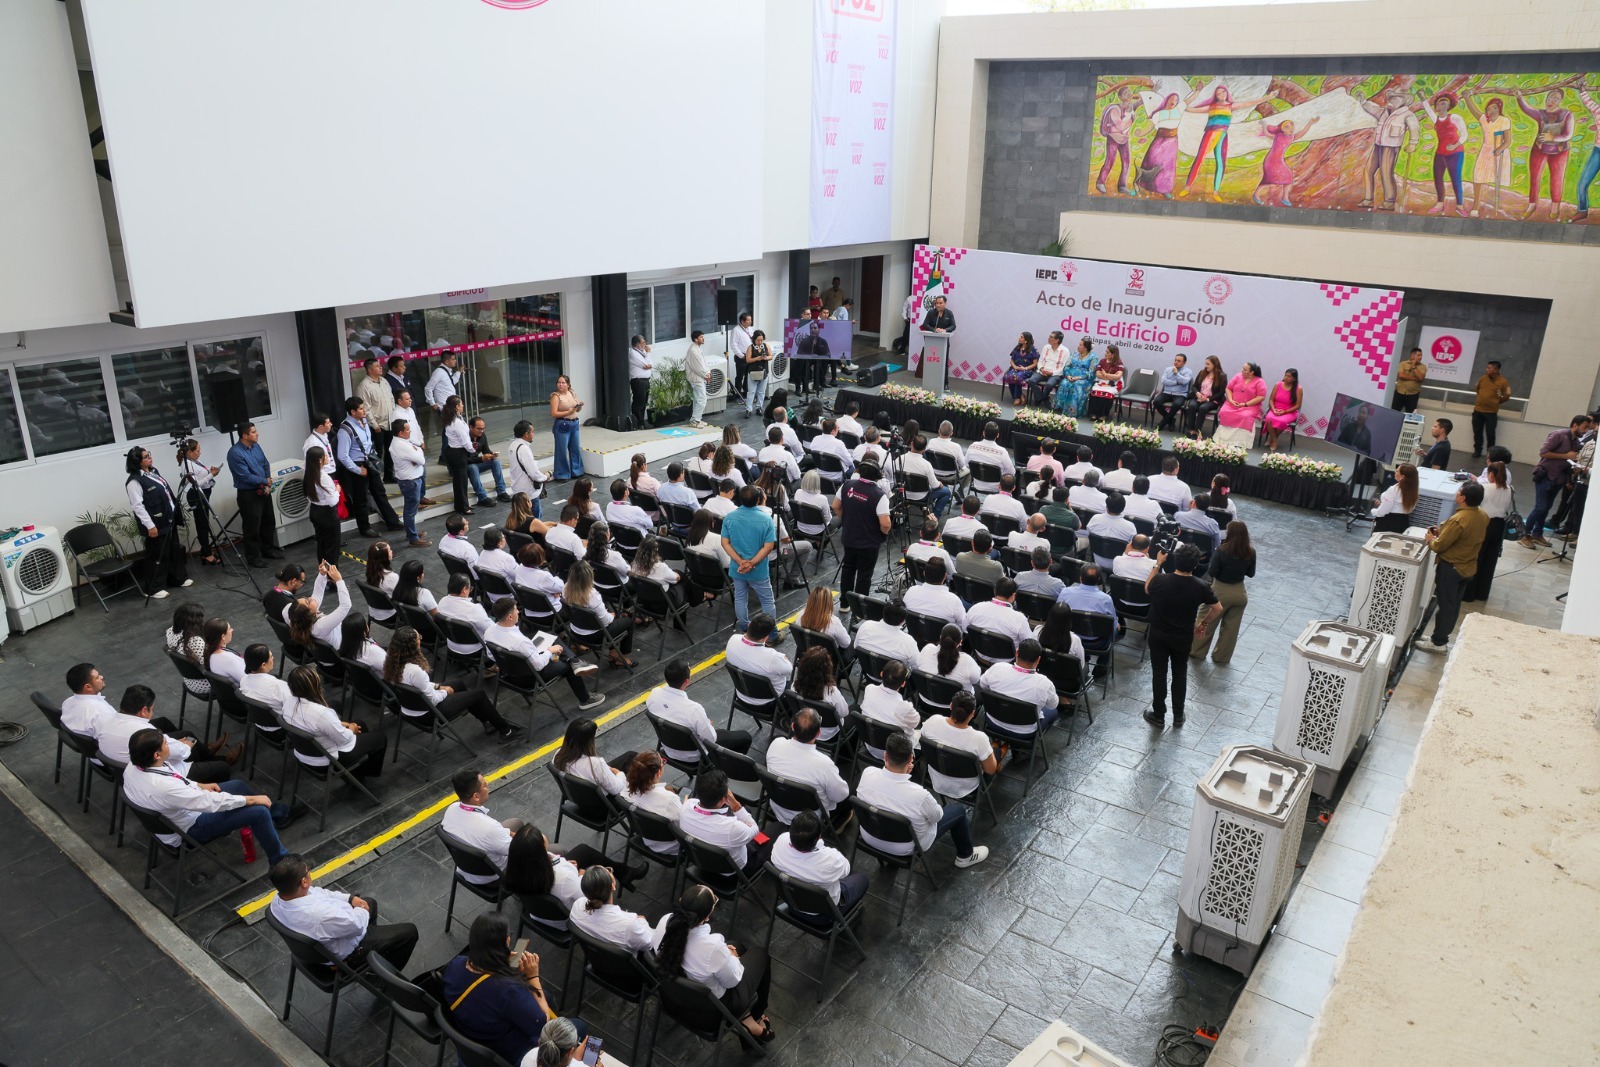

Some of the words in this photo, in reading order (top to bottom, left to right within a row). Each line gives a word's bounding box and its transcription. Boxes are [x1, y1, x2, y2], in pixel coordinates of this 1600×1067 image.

[878, 48, 888, 59] VOZ
[850, 80, 862, 93] VOZ
[874, 118, 886, 130] VOZ
[852, 154, 862, 165] VOZ
[874, 175, 885, 185] VOZ
[1035, 268, 1058, 280] IEPC
[1130, 268, 1144, 281] 32
[1036, 290, 1076, 307] Acto
[1081, 296, 1102, 311] de
[1108, 298, 1225, 326] Inauguración
[1060, 315, 1090, 334] del
[1096, 319, 1170, 343] Edificio
[1175, 324, 1198, 347] D
[1144, 343, 1164, 352] 2026
[1436, 352, 1455, 361] IEPC
